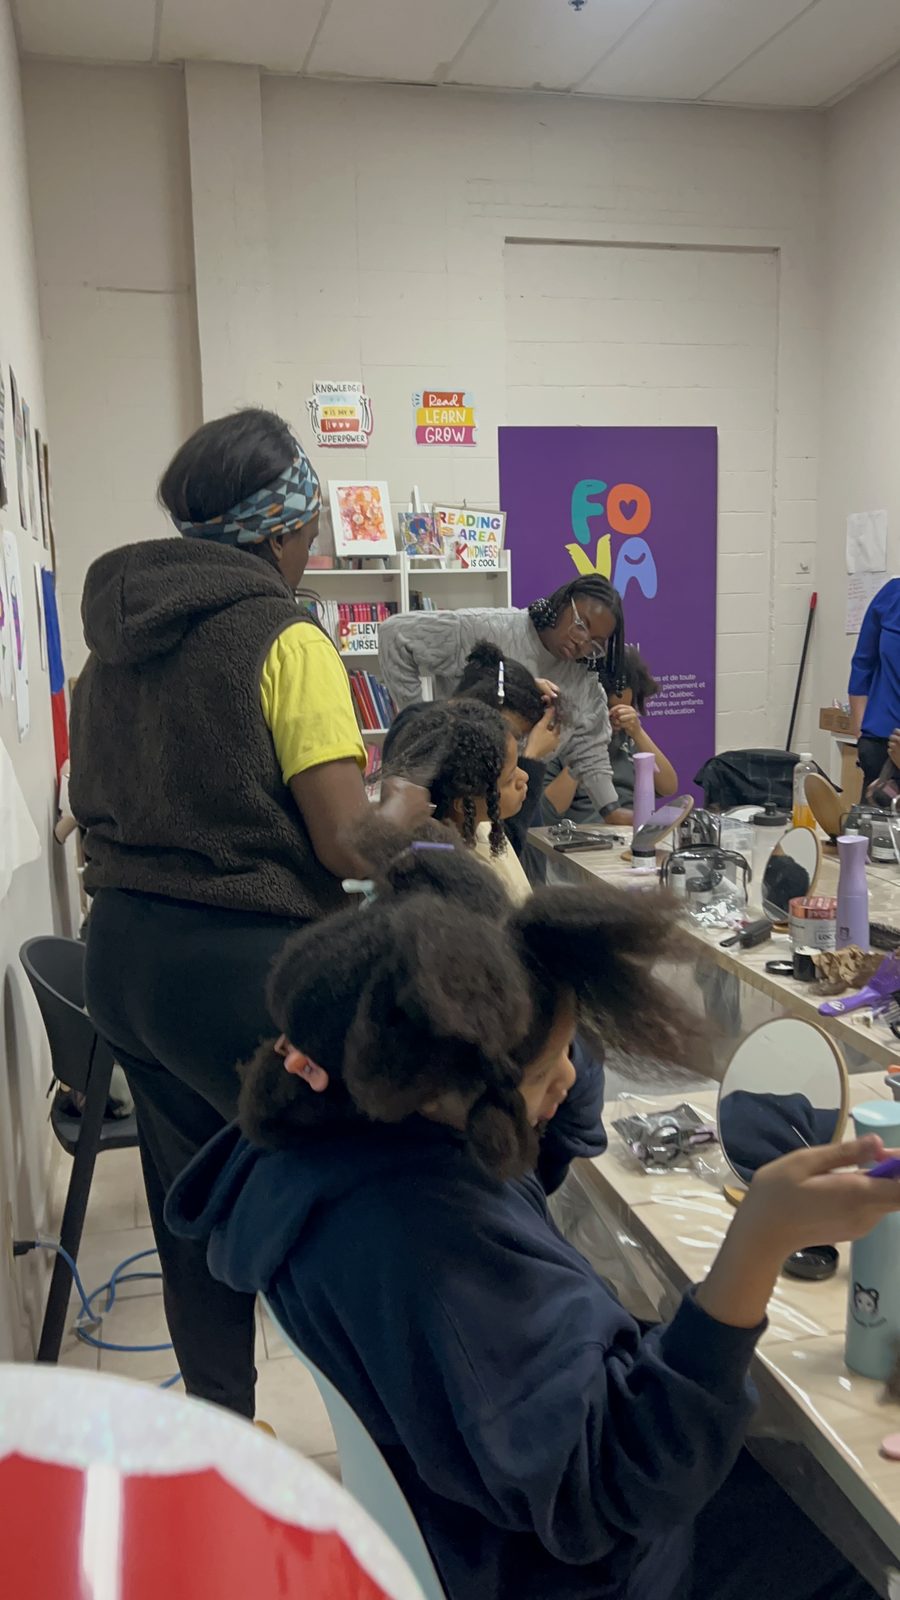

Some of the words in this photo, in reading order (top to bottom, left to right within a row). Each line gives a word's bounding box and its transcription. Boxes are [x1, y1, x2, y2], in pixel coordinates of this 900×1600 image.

[315, 383, 361, 393] KNOWLEDGE
[428, 394, 459, 407] Read
[426, 409, 466, 424] LEARN
[316, 433, 366, 443] SUPERPOWER
[425, 427, 466, 444] GROW
[438, 511, 501, 530] READING
[458, 528, 496, 543] AREA
[454, 541, 498, 569] KINDNESS
[470, 559, 477, 567] IS
[478, 559, 496, 567] COOL
[338, 619, 378, 637] BELIEV
[663, 682, 698, 690] pleinement
[681, 698, 704, 706] enfants
[664, 707, 696, 715] éducation
